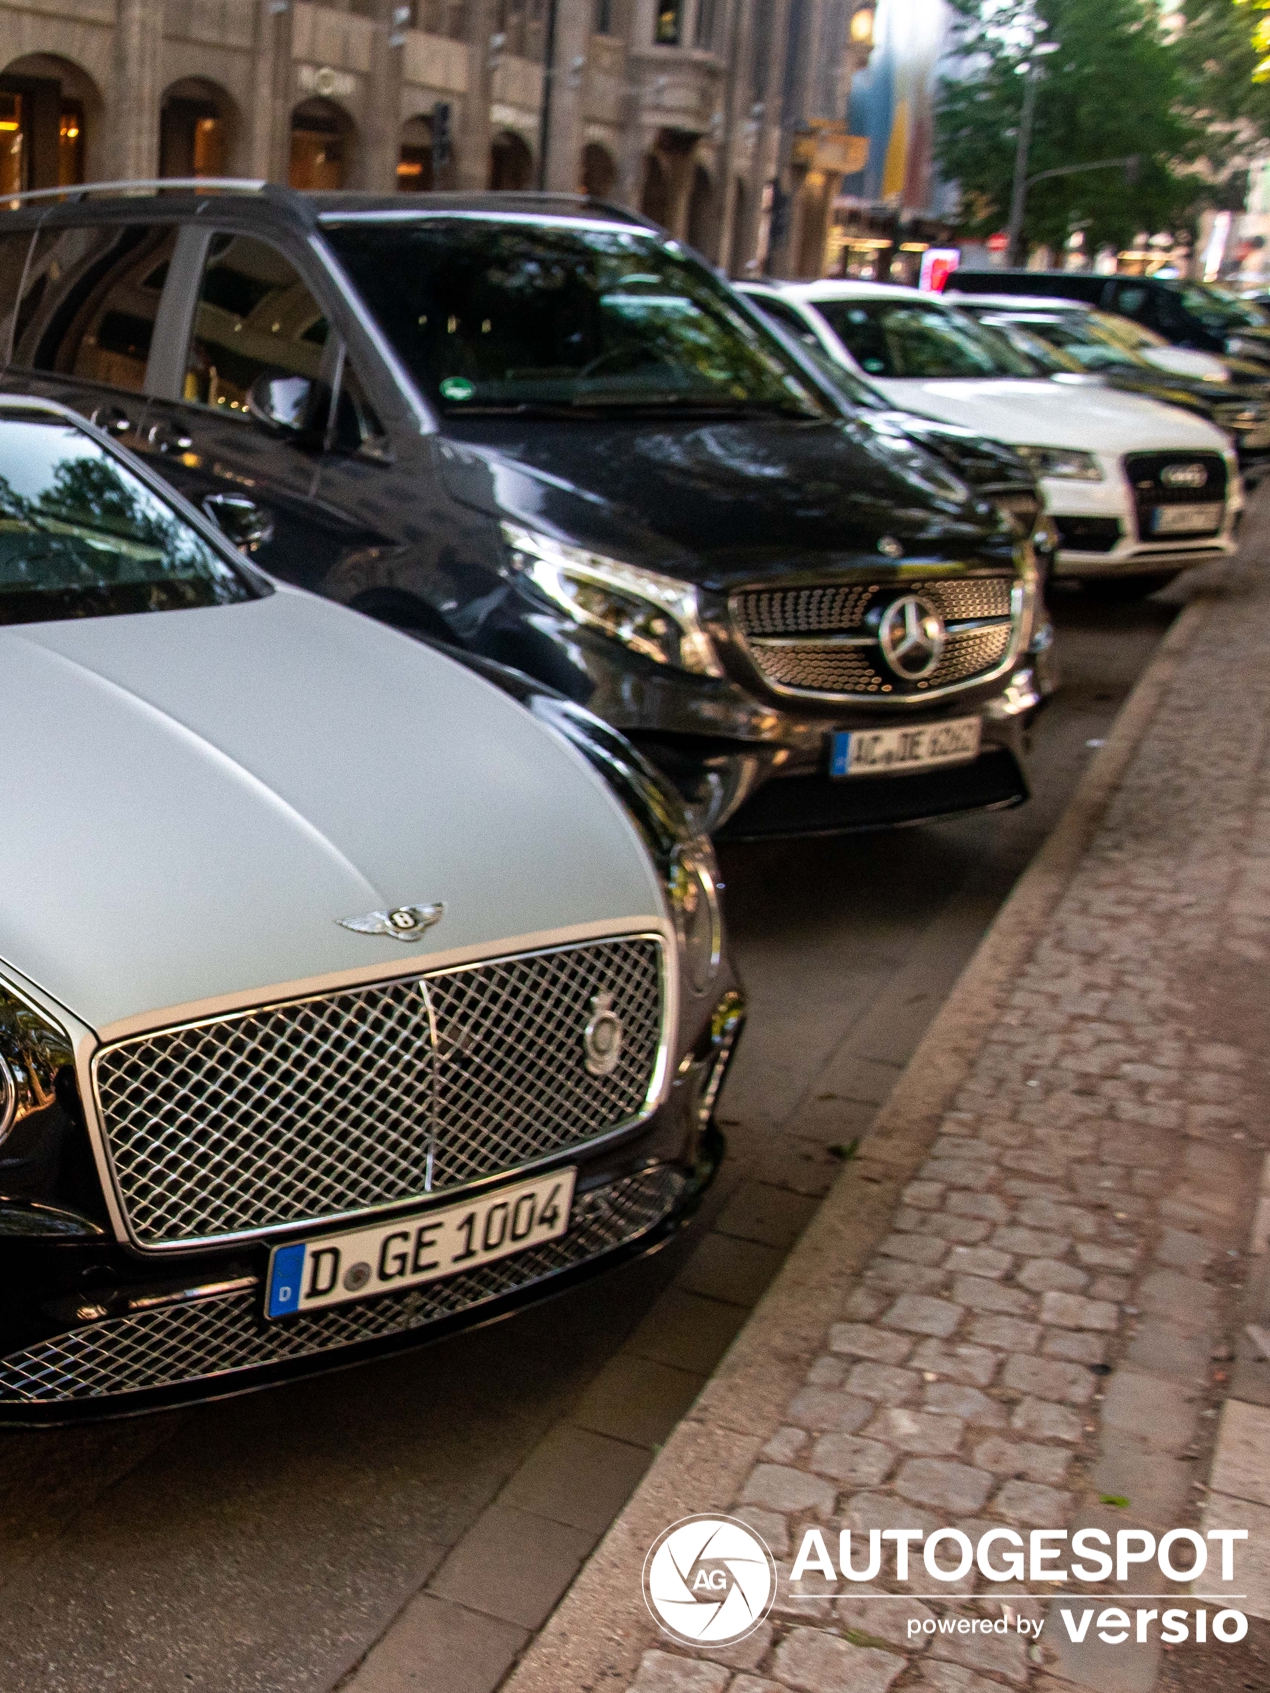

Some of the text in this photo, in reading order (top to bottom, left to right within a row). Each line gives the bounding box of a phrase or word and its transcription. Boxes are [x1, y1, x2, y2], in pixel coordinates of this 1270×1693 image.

[304, 1183, 562, 1299] D GE 1004
